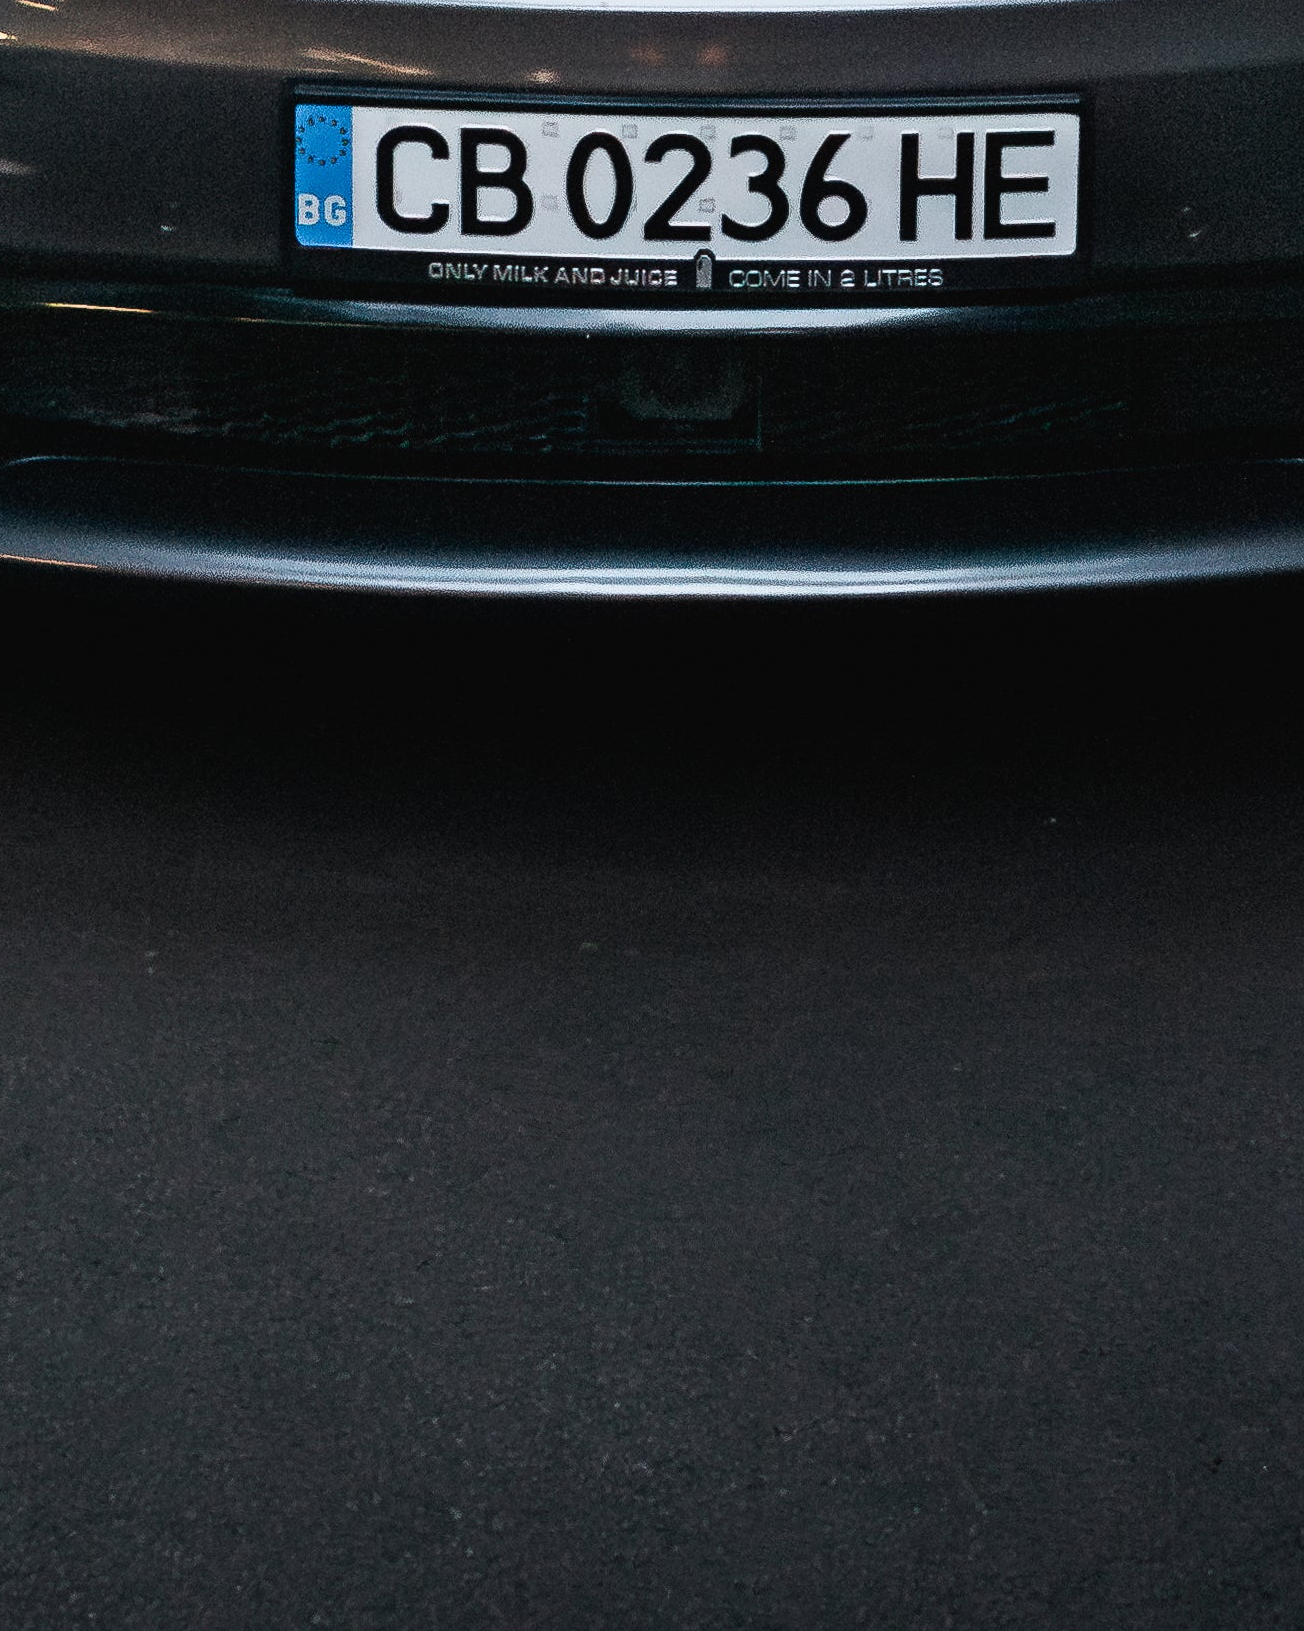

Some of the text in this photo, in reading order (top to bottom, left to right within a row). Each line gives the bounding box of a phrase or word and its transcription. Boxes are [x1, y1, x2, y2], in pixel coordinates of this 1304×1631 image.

[376, 125, 1056, 241] CB 0236 HE
[298, 193, 346, 226] BG
[428, 262, 944, 288] ONLY MILK AND JUICE COME IN 2 LITRES
